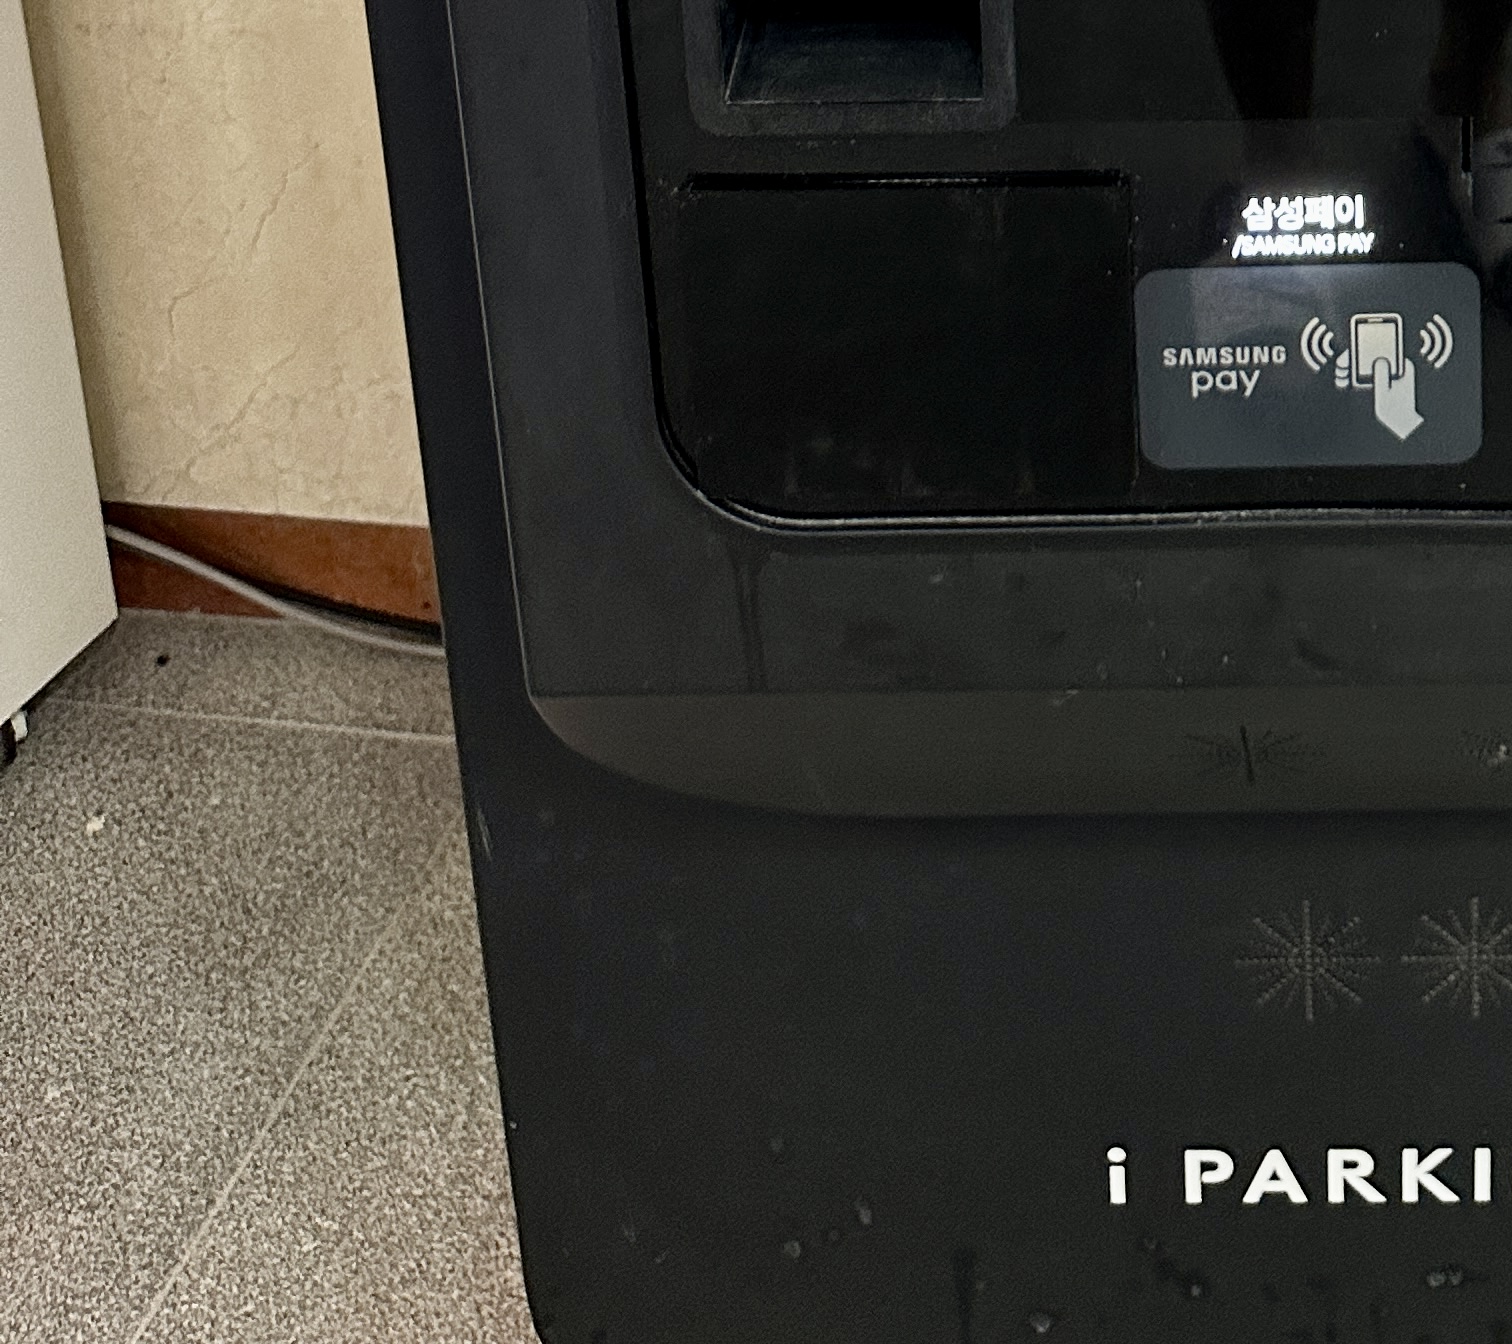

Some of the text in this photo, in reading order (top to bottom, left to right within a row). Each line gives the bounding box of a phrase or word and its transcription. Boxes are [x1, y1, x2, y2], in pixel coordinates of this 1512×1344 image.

[1241, 193, 1365, 232] 삼성페이
[1336, 231, 1375, 255] PAY
[1162, 346, 1287, 367] SAMSUNG
[1190, 368, 1261, 399] pay
[1105, 1146, 1128, 1205] i
